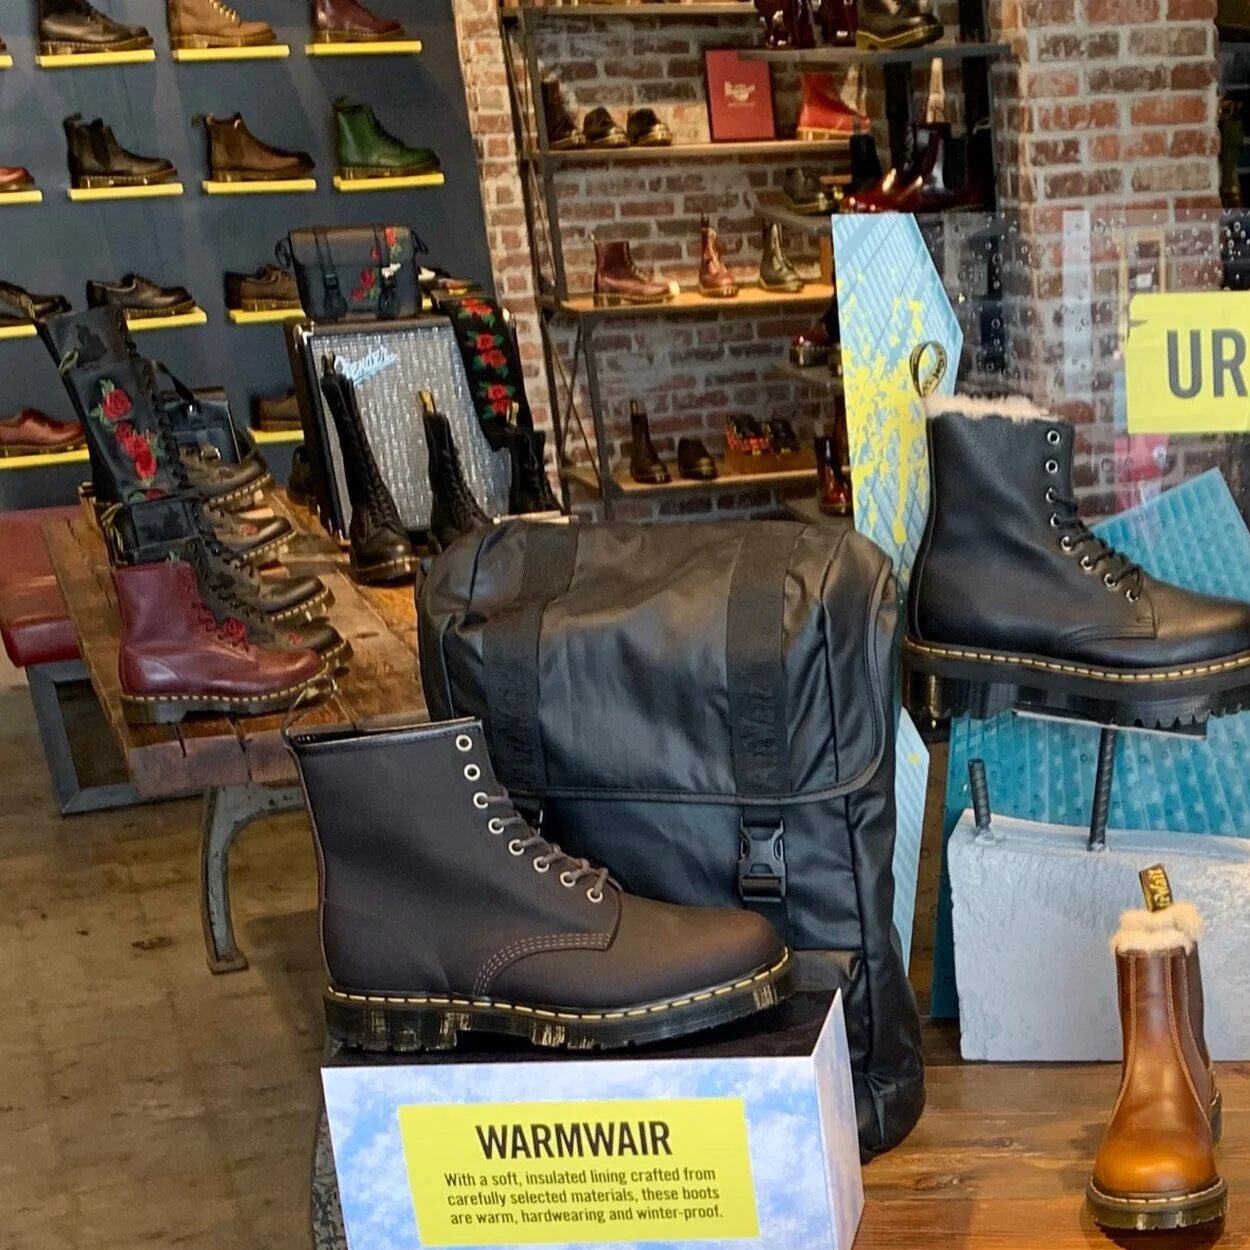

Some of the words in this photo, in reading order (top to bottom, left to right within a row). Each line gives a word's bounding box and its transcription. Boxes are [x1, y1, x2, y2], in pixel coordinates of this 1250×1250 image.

[474, 1120, 674, 1160] WARMWAIR
[444, 1172, 477, 1187] With
[479, 1175, 489, 1186] a
[491, 1171, 523, 1187] soft,
[525, 1169, 588, 1185] insulated
[589, 1169, 628, 1185] lining
[630, 1168, 681, 1183] crafted
[682, 1166, 717, 1181] from
[447, 1191, 507, 1208] carefully
[510, 1190, 568, 1204] selected
[570, 1188, 639, 1203] materials,
[642, 1187, 679, 1202] these
[681, 1186, 721, 1201] boots
[450, 1213, 474, 1225] are
[475, 1212, 519, 1226] warm,
[521, 1209, 607, 1224] hardwearing
[608, 1206, 634, 1221] and
[636, 1204, 724, 1221] winter-proof.
